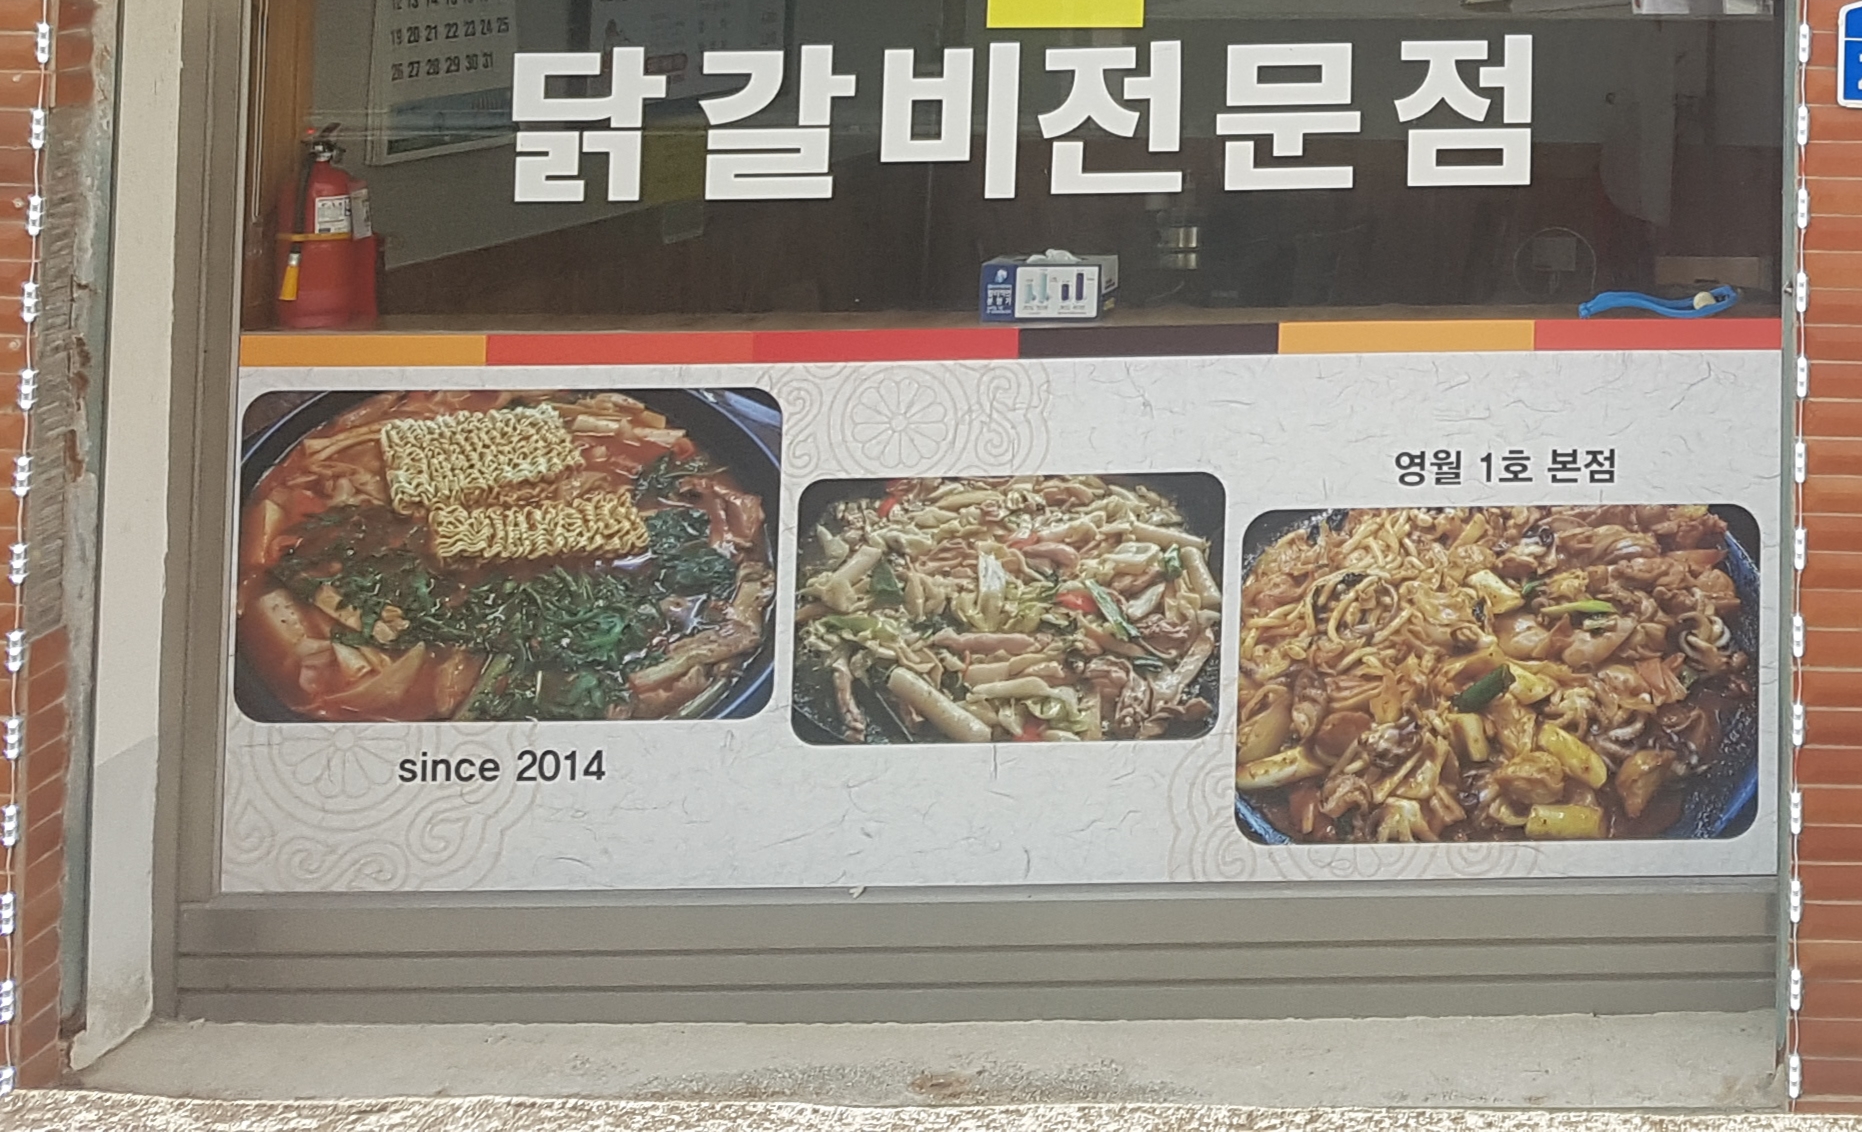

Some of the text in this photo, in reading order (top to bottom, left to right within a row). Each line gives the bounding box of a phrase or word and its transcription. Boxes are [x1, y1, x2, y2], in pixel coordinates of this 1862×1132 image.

[407, 26, 420, 44] 20
[425, 24, 438, 42] 21
[444, 22, 459, 39] 22
[464, 20, 476, 37] 23
[480, 19, 493, 36] 24
[408, 61, 421, 78] 27
[445, 56, 460, 74] 29
[1395, 448, 1615, 486] 영월 1호 본점
[398, 750, 606, 783] since 2014
